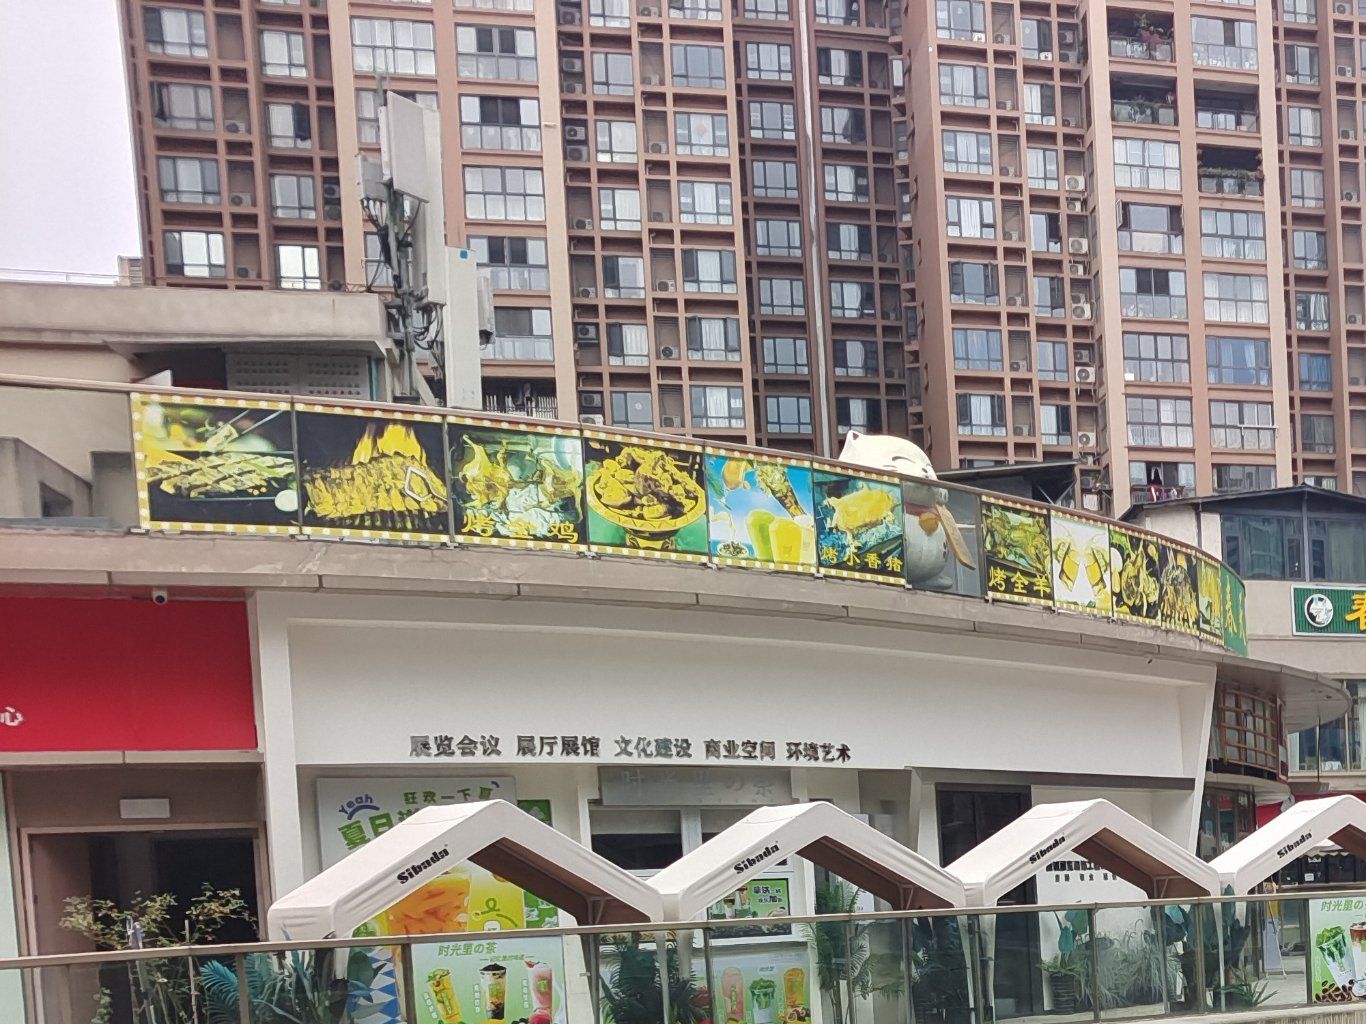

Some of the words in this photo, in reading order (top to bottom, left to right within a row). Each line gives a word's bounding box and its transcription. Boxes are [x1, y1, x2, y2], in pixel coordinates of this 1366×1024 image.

[820, 545, 904, 573] 烤小香猪
[988, 564, 1051, 597] 烤全羊
[409, 734, 502, 758] 展览会议
[515, 734, 600, 758] 展厅展馆
[614, 735, 693, 758] 文化建设
[703, 738, 776, 762] 商业空间
[786, 741, 851, 764] 环境艺术
